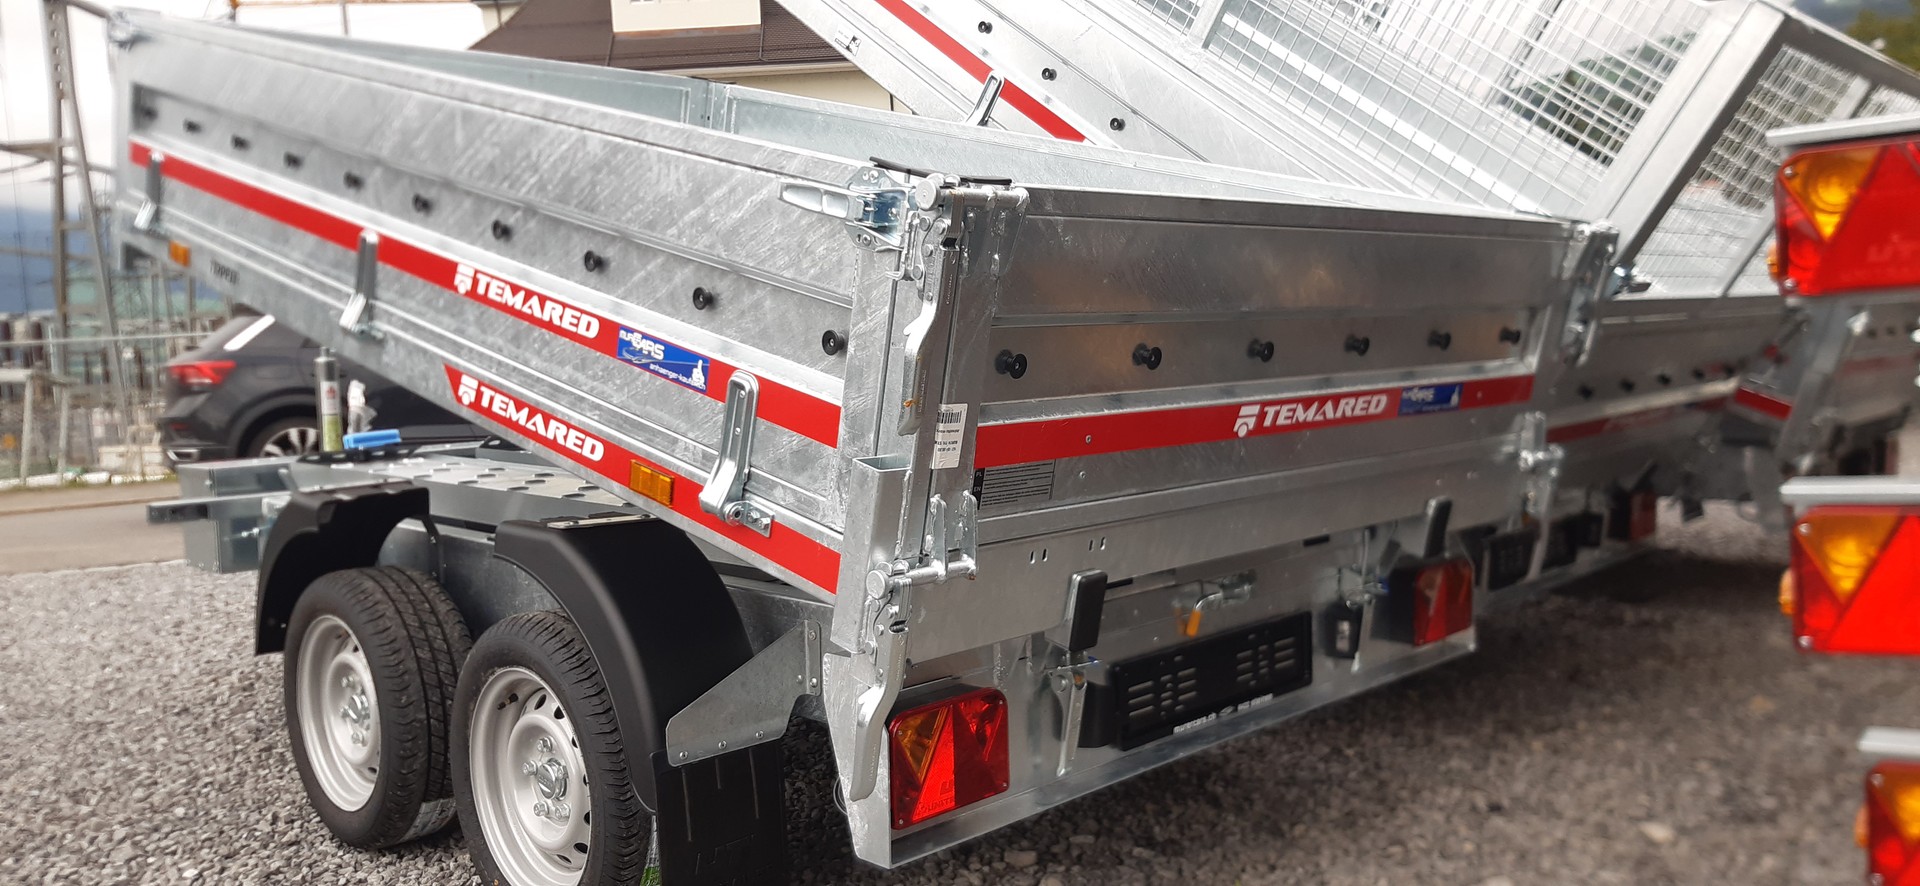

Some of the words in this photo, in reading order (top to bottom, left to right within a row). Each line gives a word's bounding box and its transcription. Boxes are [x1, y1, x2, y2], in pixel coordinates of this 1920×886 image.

[475, 273, 600, 339] TEMARED
[479, 385, 605, 462] TEMARED
[1262, 393, 1388, 428] TEMARED
